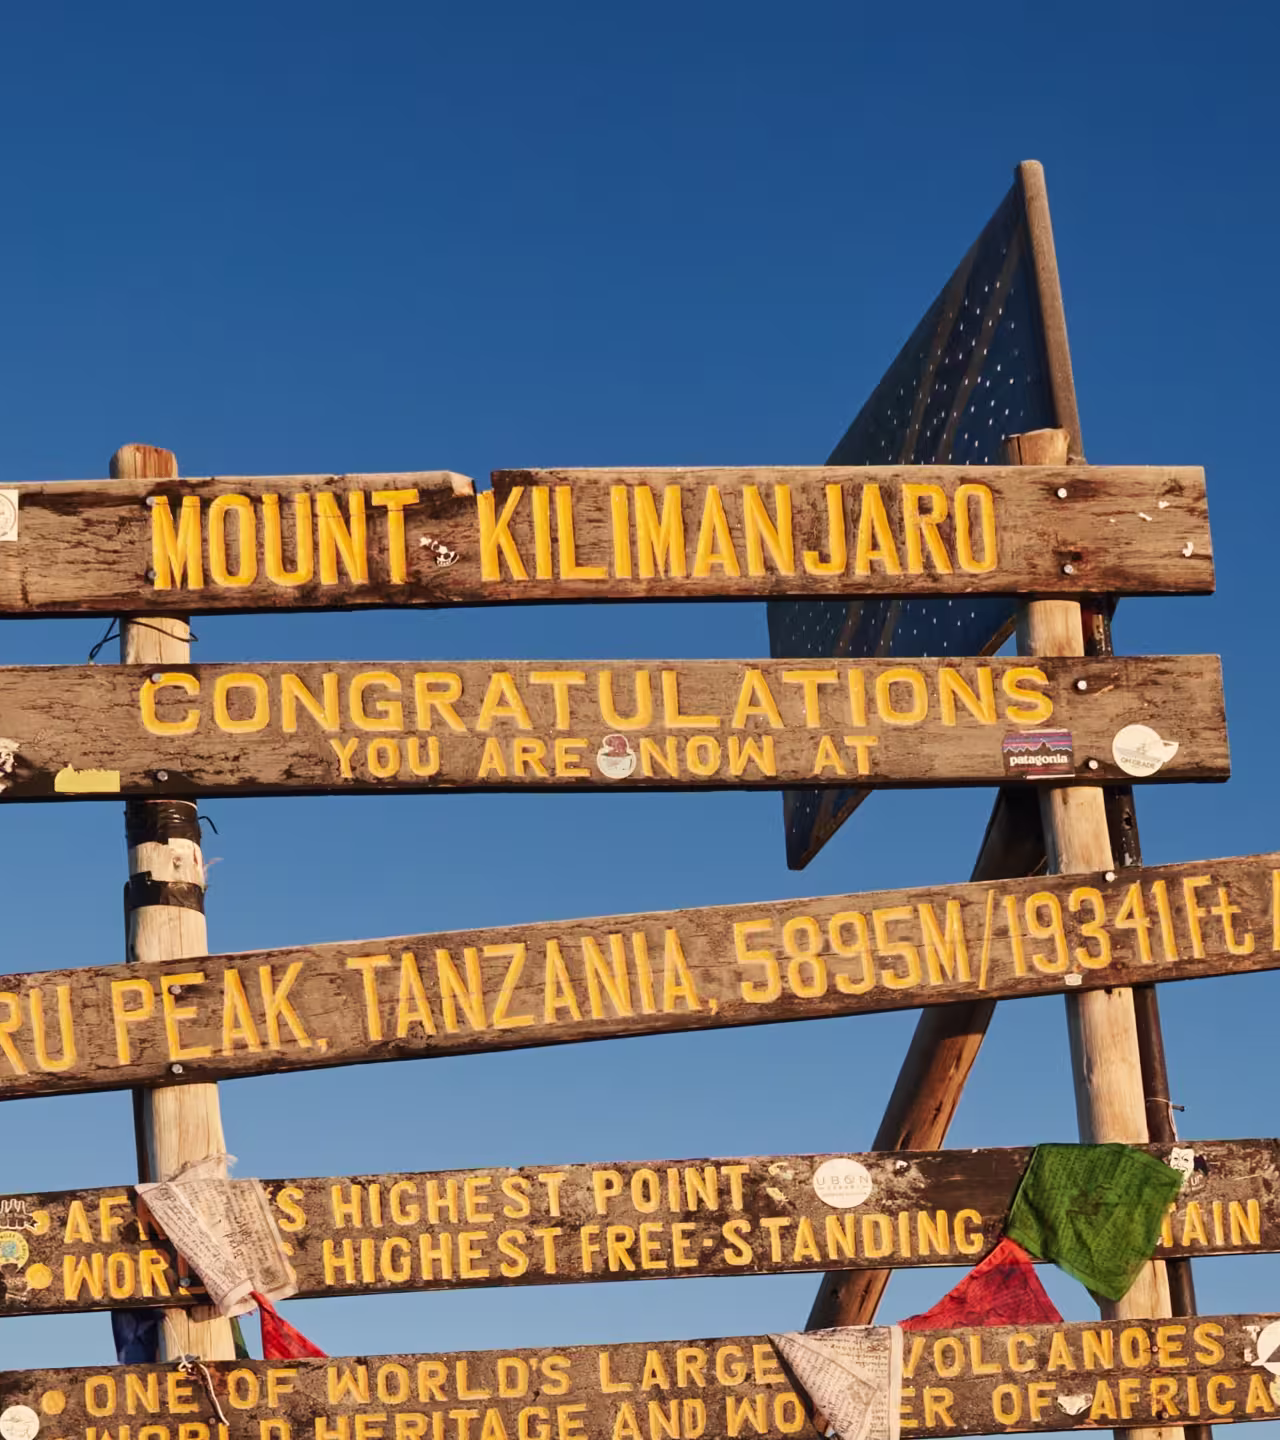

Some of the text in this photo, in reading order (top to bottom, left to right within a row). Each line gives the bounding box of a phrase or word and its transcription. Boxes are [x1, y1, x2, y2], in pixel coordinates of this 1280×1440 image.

[152, 484, 997, 589] MOUNT KILIMANJARO
[140, 667, 1053, 735] CONGRATULATIONS
[329, 735, 880, 778] YOU ARE NOW AT
[1009, 753, 1068, 767] patagonia
[346, 928, 718, 1040] TANZANIA,
[331, 1172, 566, 1229] HIGHEST
[593, 1164, 749, 1214] POINT
[323, 1226, 563, 1285] HIGHEST
[580, 1209, 983, 1273] FREE-STANDING
[85, 1371, 199, 1417] ONE
[227, 1368, 297, 1409] OF
[327, 1356, 572, 1405] WORLD'S
[599, 1344, 785, 1393] LARGE
[725, 1387, 955, 1437] WOER
[992, 1381, 1057, 1425] OF
[1089, 1373, 1275, 1420] AFRICA
